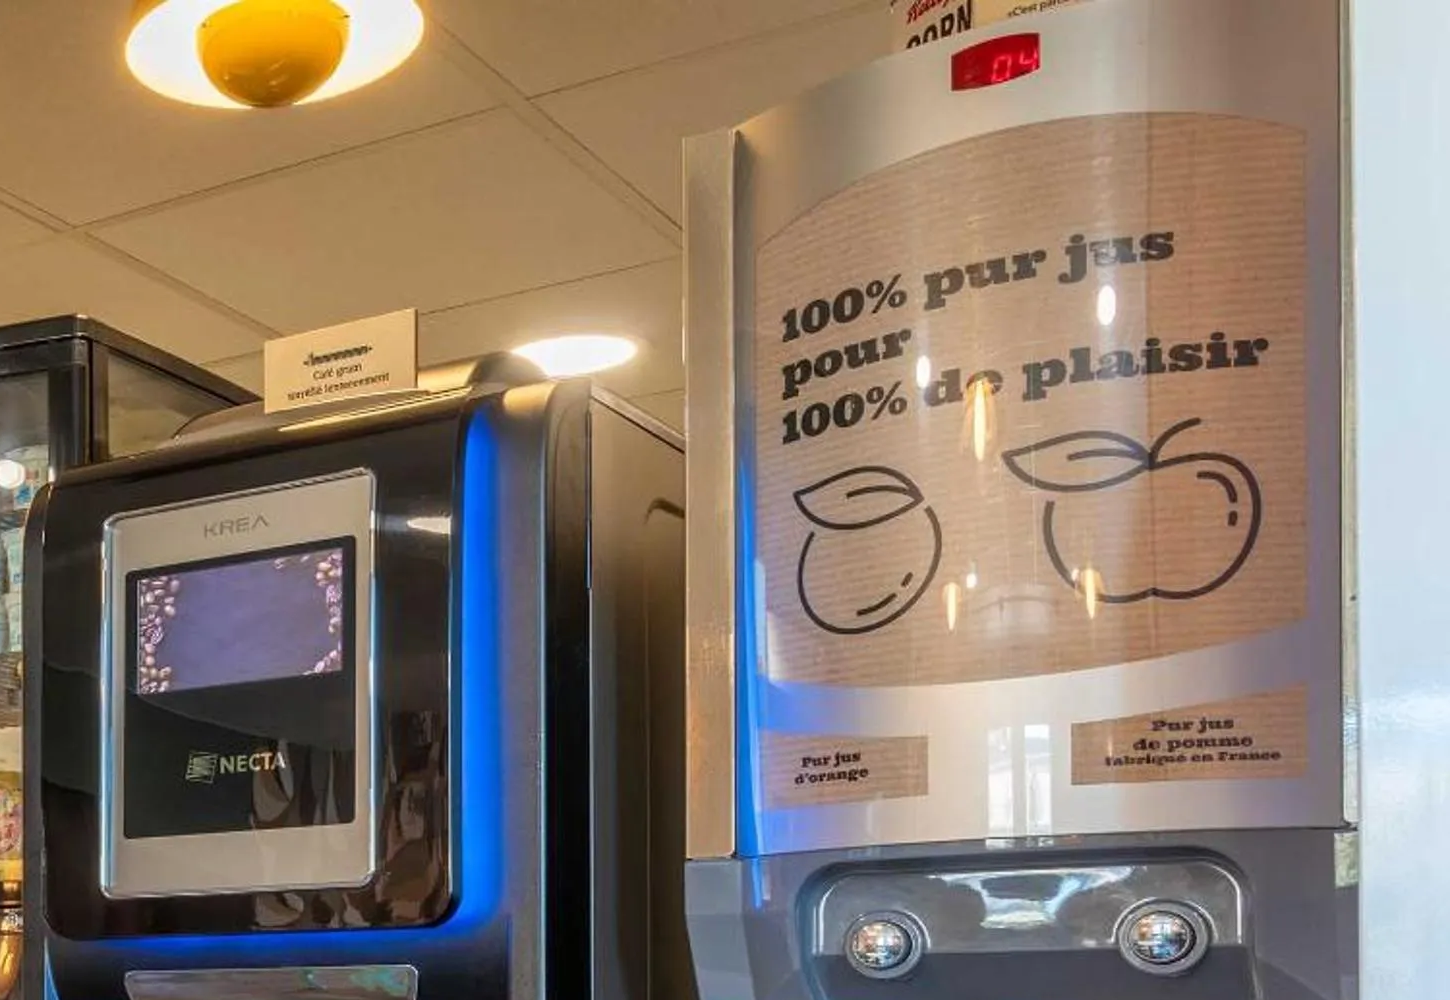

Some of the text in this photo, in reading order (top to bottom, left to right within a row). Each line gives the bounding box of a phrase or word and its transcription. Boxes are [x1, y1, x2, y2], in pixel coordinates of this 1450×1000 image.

[781, 231, 1175, 342] 100% pur jus
[781, 328, 912, 399] pour
[781, 332, 1269, 444] 100% de plaisir
[204, 516, 269, 538] KREA
[1152, 716, 1234, 733] Pur jus
[1133, 735, 1253, 752] de pomme
[219, 752, 286, 775] NECTA
[801, 751, 861, 768] Pur jus
[1218, 750, 1281, 763] France
[794, 768, 868, 784] d'orange
